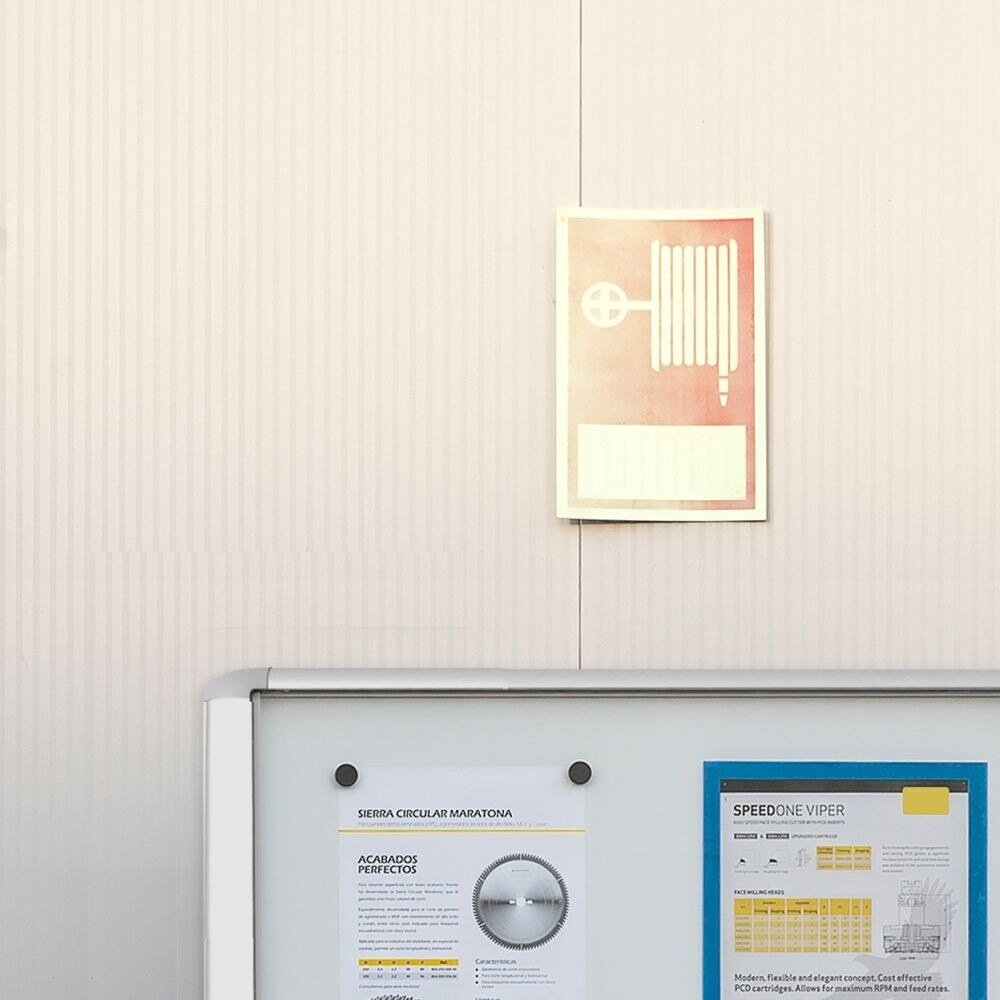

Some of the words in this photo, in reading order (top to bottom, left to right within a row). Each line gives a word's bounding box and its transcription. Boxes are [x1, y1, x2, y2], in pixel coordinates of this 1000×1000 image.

[358, 808, 394, 819] SIERRA
[396, 808, 448, 819] CIRCULAR
[450, 808, 513, 819] MARATONA
[733, 804, 803, 817] SPEEDONE
[806, 804, 845, 817] VIPER
[357, 855, 418, 864] ACABADOS
[357, 865, 417, 874] PERFECTOS
[734, 973, 766, 982] Modern,
[768, 973, 797, 982] flexible
[798, 973, 813, 982] and
[813, 973, 843, 984] elegant
[844, 974, 877, 984] concept.
[877, 973, 896, 982] Cost
[897, 973, 932, 982] effective
[734, 984, 751, 992] PCD
[752, 984, 794, 994] cartridges.
[795, 984, 820, 992] Allows
[822, 984, 834, 992] for
[835, 984, 873, 992] maximum
[874, 984, 892, 992] RPM
[893, 984, 908, 992] and
[909, 984, 927, 992] feed
